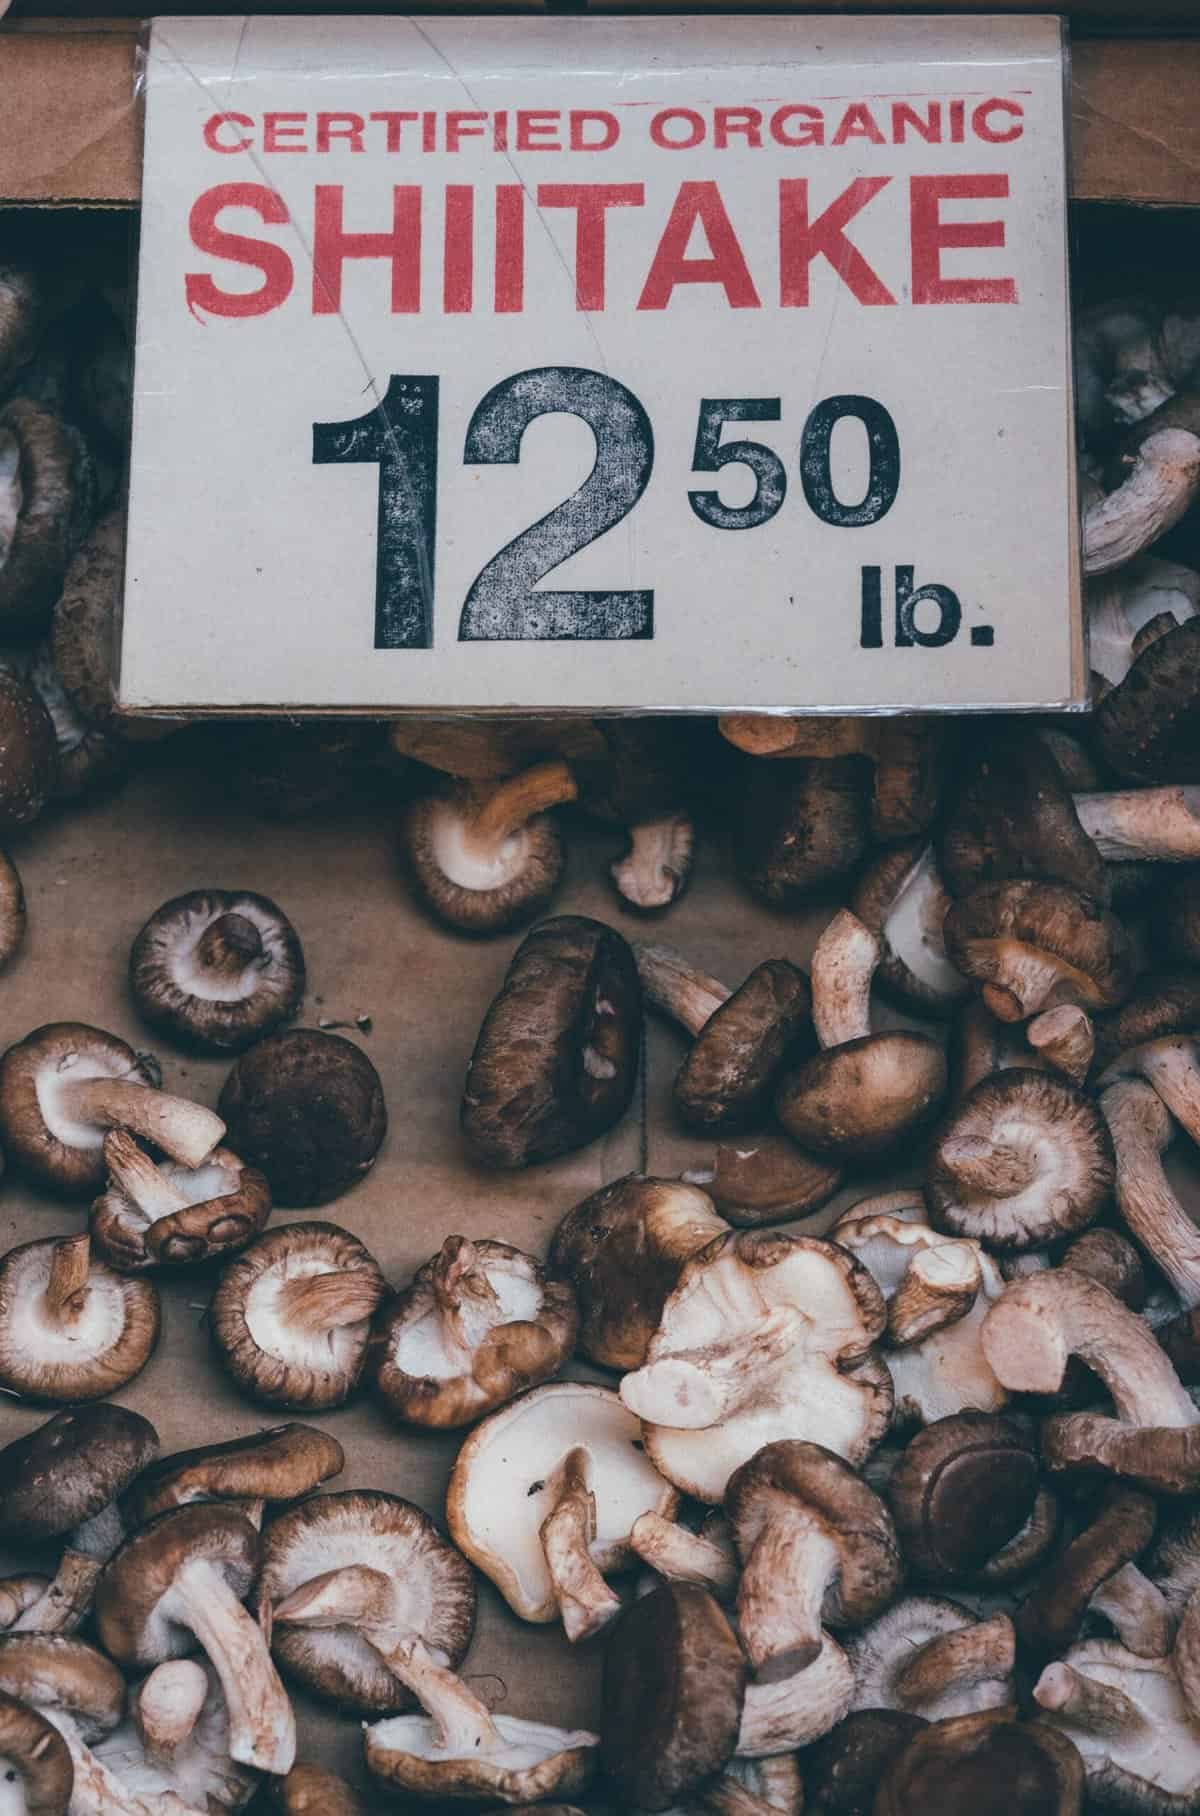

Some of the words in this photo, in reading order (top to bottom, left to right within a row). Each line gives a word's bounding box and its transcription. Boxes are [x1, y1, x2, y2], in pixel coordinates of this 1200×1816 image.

[202, 110, 621, 155] CERTIFIED
[650, 98, 1025, 150] ORGANIC
[184, 174, 1019, 326] SHIITAKE
[859, 564, 995, 649] lb.
